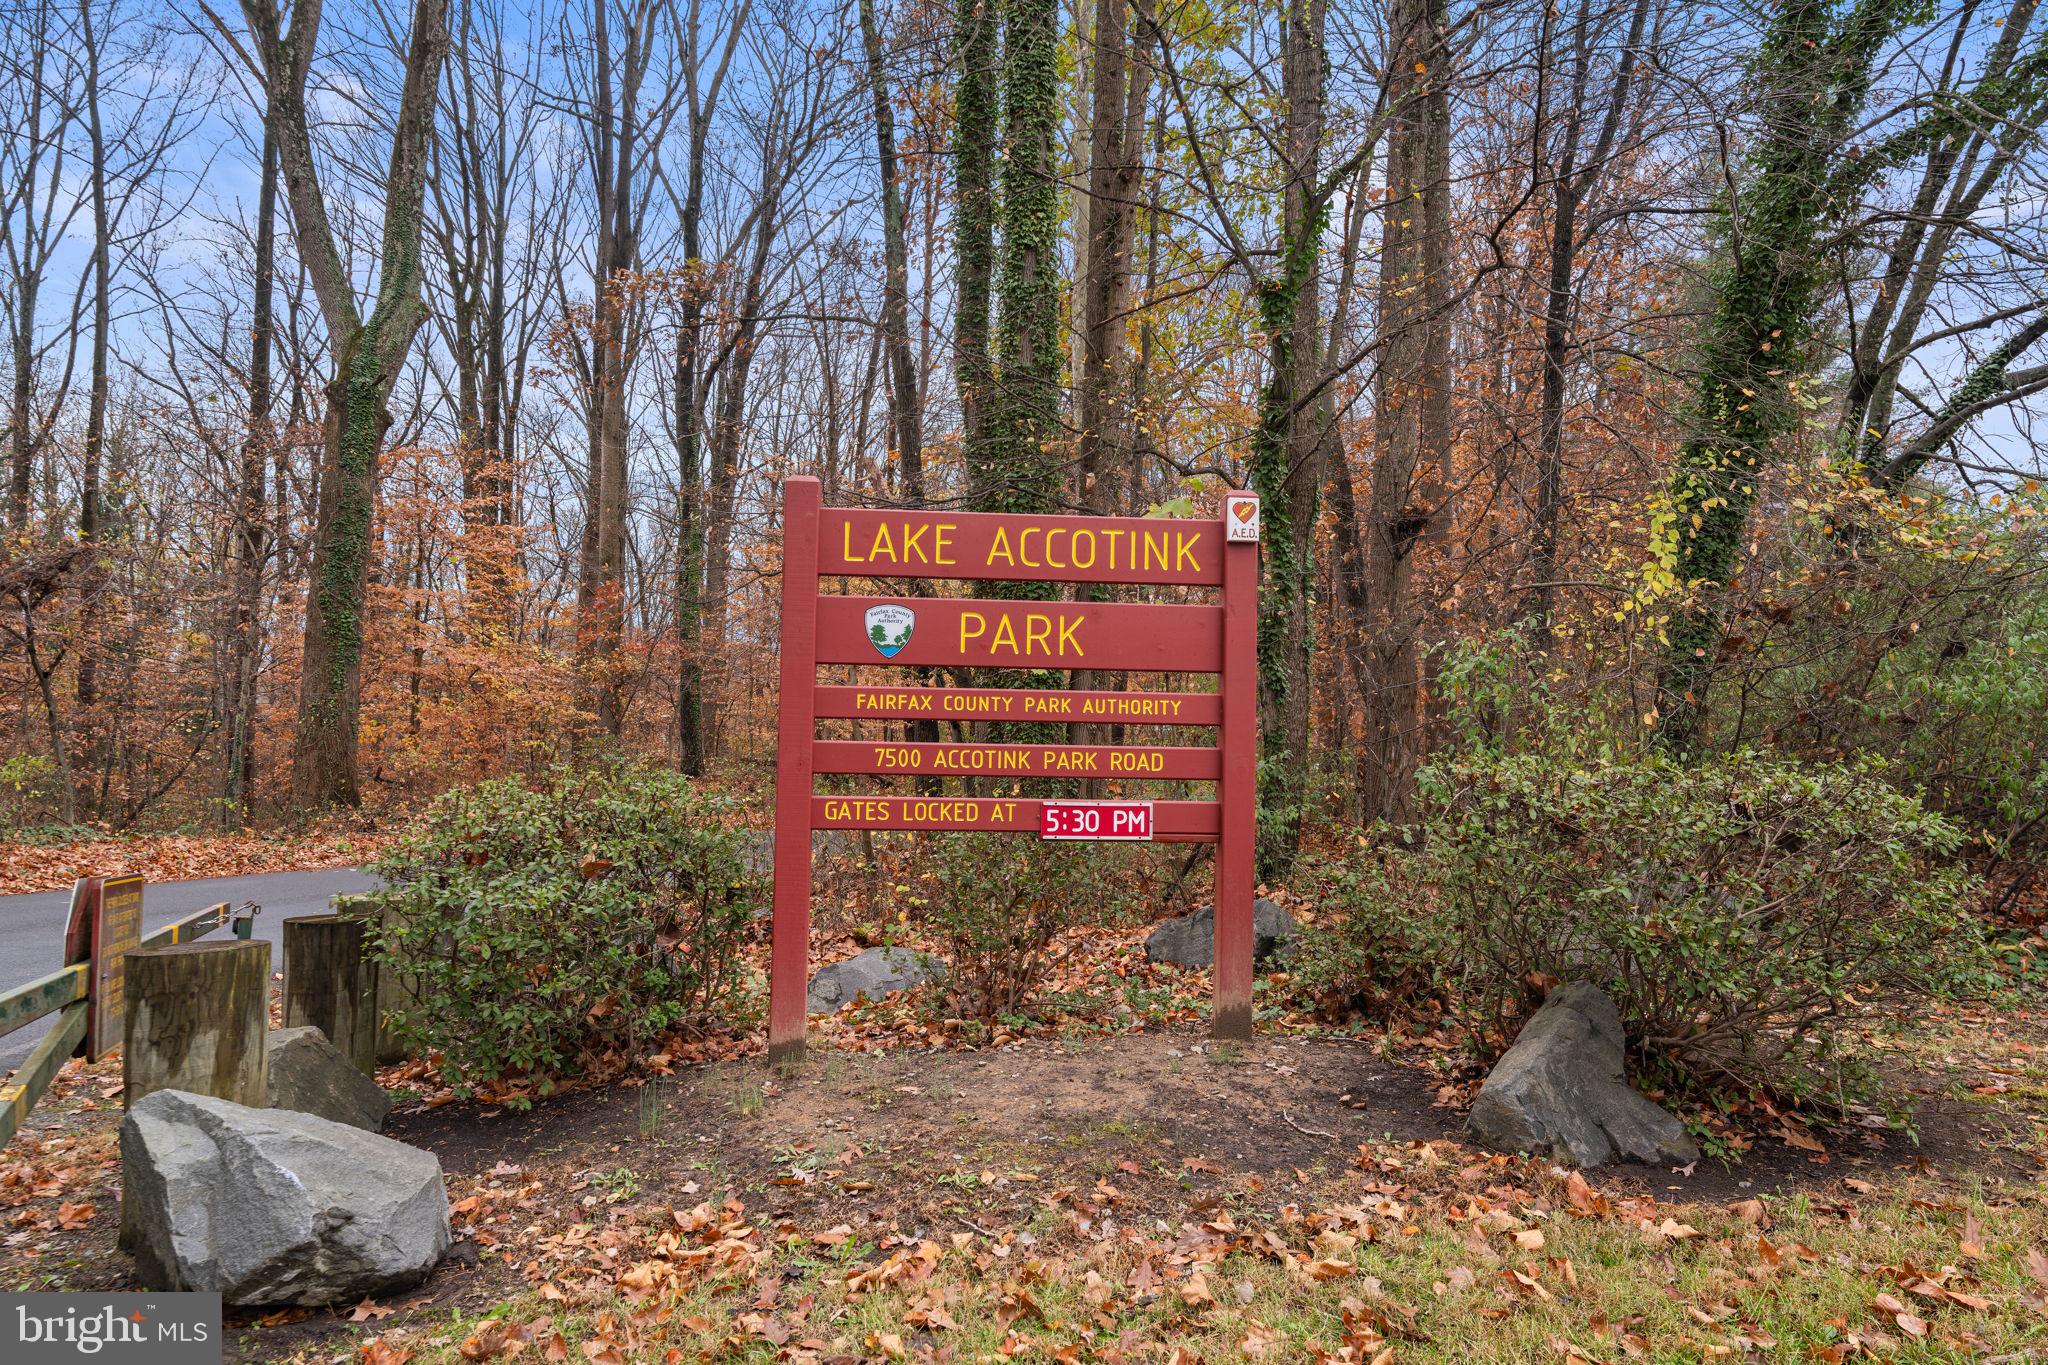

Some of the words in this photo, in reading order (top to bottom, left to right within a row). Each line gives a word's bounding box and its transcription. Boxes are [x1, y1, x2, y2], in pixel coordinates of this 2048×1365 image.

[1231, 528, 1258, 539] A.E.D.
[843, 521, 956, 564] LAKE
[987, 526, 1201, 572] ACCOTINK
[870, 609, 889, 617] Fairfax
[891, 609, 911, 619] County
[960, 612, 1085, 656] PARK
[856, 693, 933, 711] FAIRFAX
[943, 695, 1014, 713] COUNTY
[1024, 697, 1072, 713] PARK
[1082, 698, 1182, 716] AUTHORITY
[874, 747, 921, 768] 7500
[933, 749, 1031, 769] ACCOTINK
[1043, 750, 1098, 770] PARK
[1110, 752, 1164, 772] ROAD
[824, 800, 890, 821] GATES
[903, 801, 979, 822] LOCKED
[990, 802, 1017, 822] AT
[1046, 809, 1100, 833] 5:30
[1113, 810, 1145, 833] PM
